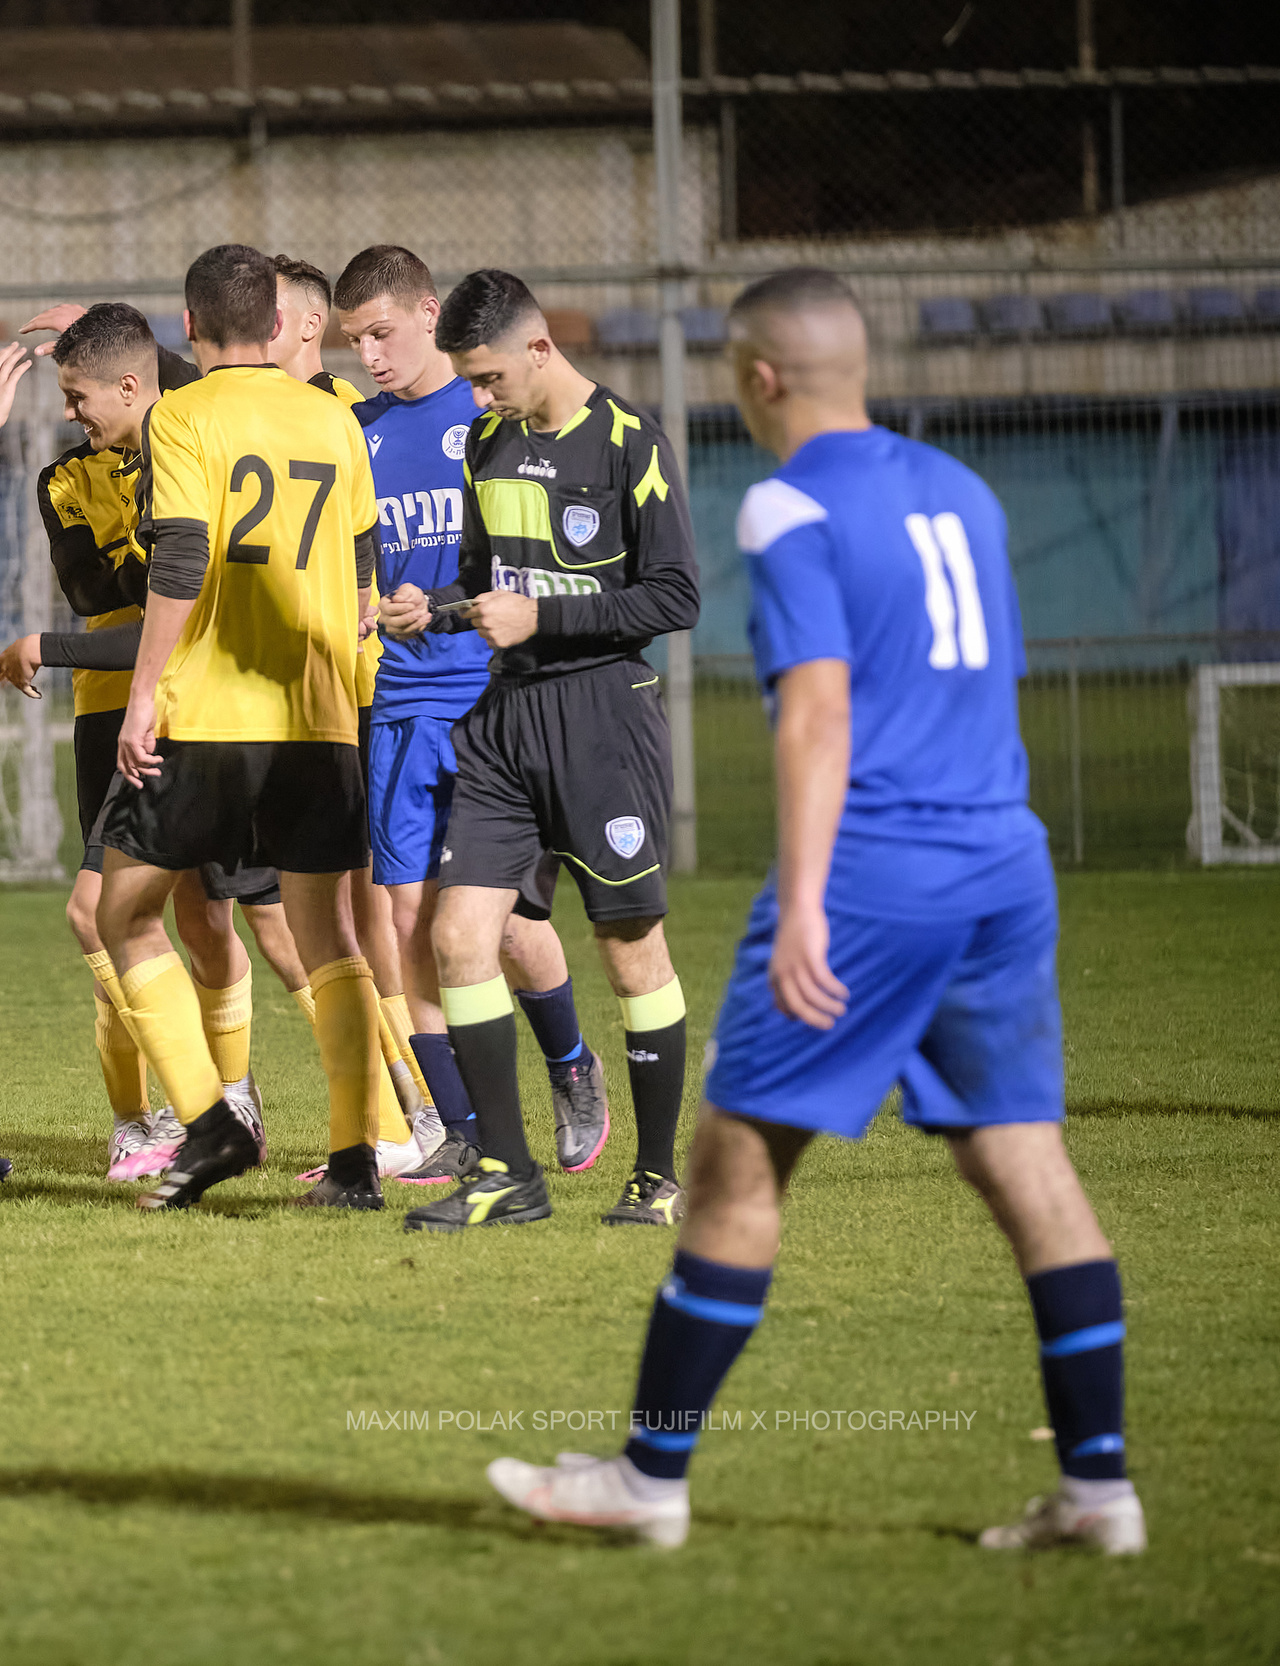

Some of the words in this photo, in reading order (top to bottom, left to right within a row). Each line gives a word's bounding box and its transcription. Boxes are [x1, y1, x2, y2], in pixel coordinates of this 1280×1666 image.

[226, 454, 336, 570] 27
[376, 488, 463, 551] מניף
[904, 511, 989, 670] 11
